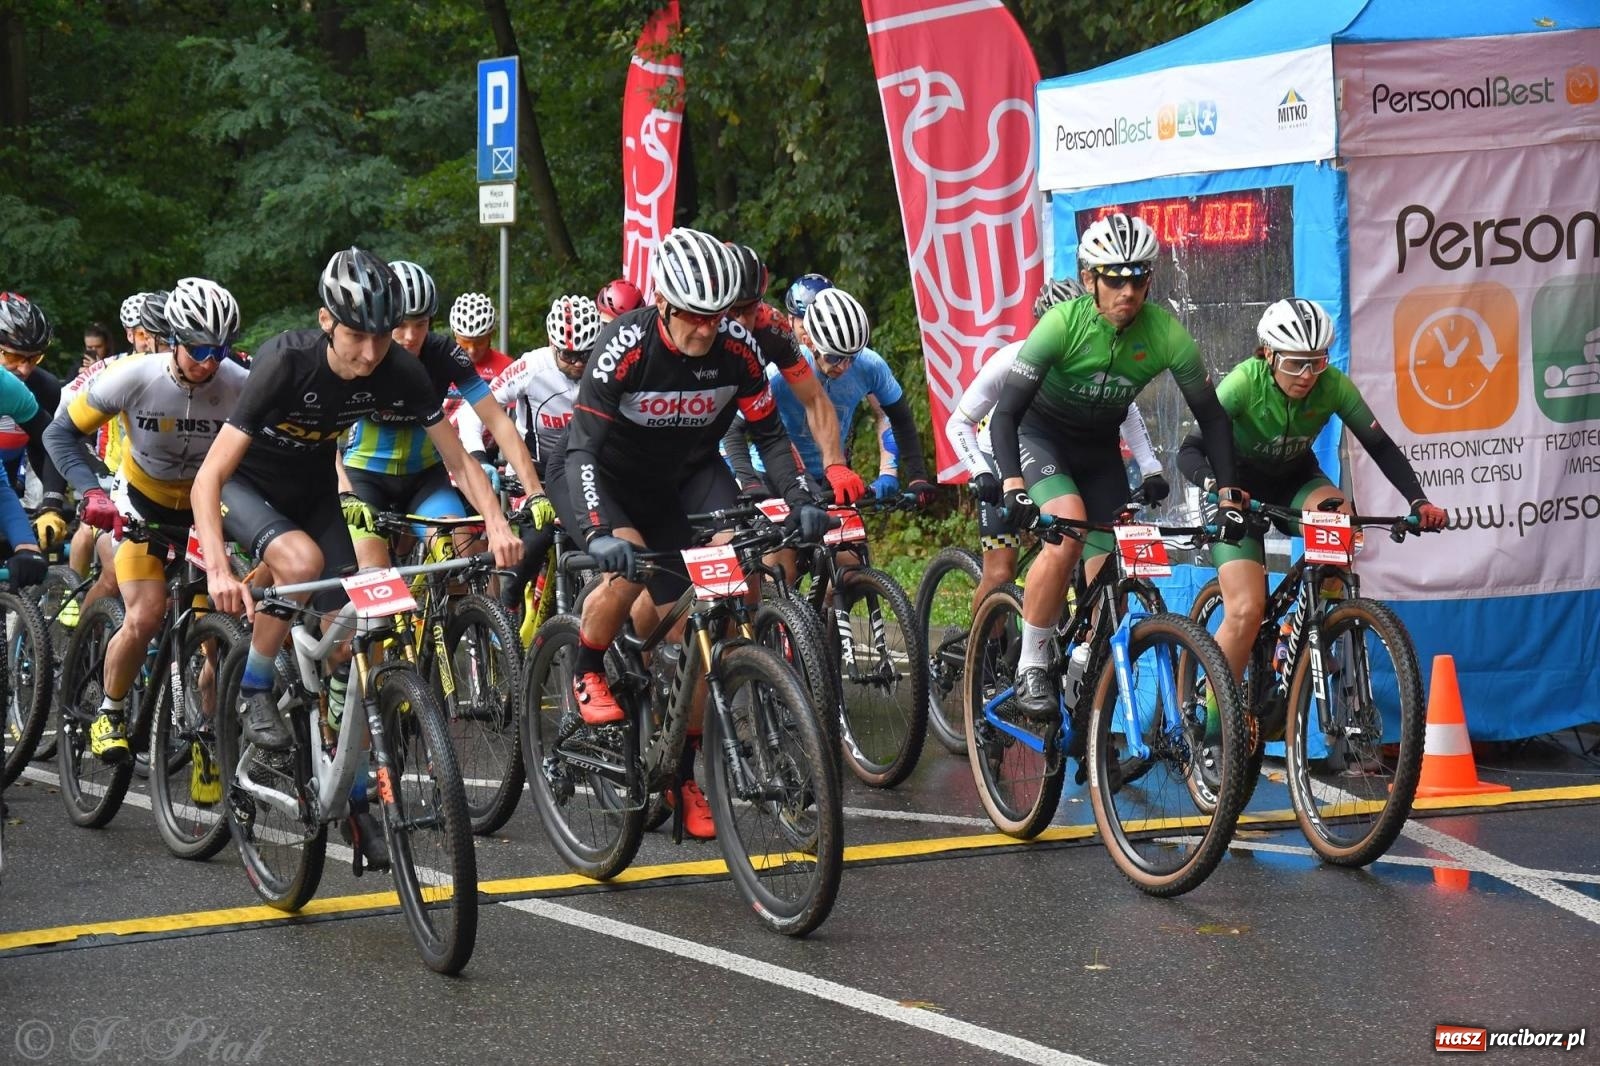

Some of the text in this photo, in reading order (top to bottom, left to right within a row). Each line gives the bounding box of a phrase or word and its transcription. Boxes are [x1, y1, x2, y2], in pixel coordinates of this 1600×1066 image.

[1372, 75, 1555, 114] PersonalBest
[486, 71, 509, 146] P
[1277, 104, 1308, 123] MITKO
[1056, 115, 1153, 151] PersonalBest
[1396, 204, 1600, 274] Person
[639, 392, 717, 416] SOKÓŁ
[136, 415, 212, 433] TAURUS
[647, 418, 708, 427] ROWERY
[1398, 436, 1525, 463] LEKTRONICZNY
[1471, 463, 1523, 484] CZASU
[581, 464, 600, 510] SOKÓŁ
[1315, 529, 1341, 546] 38
[700, 563, 731, 580] 22
[363, 585, 393, 601] 10
